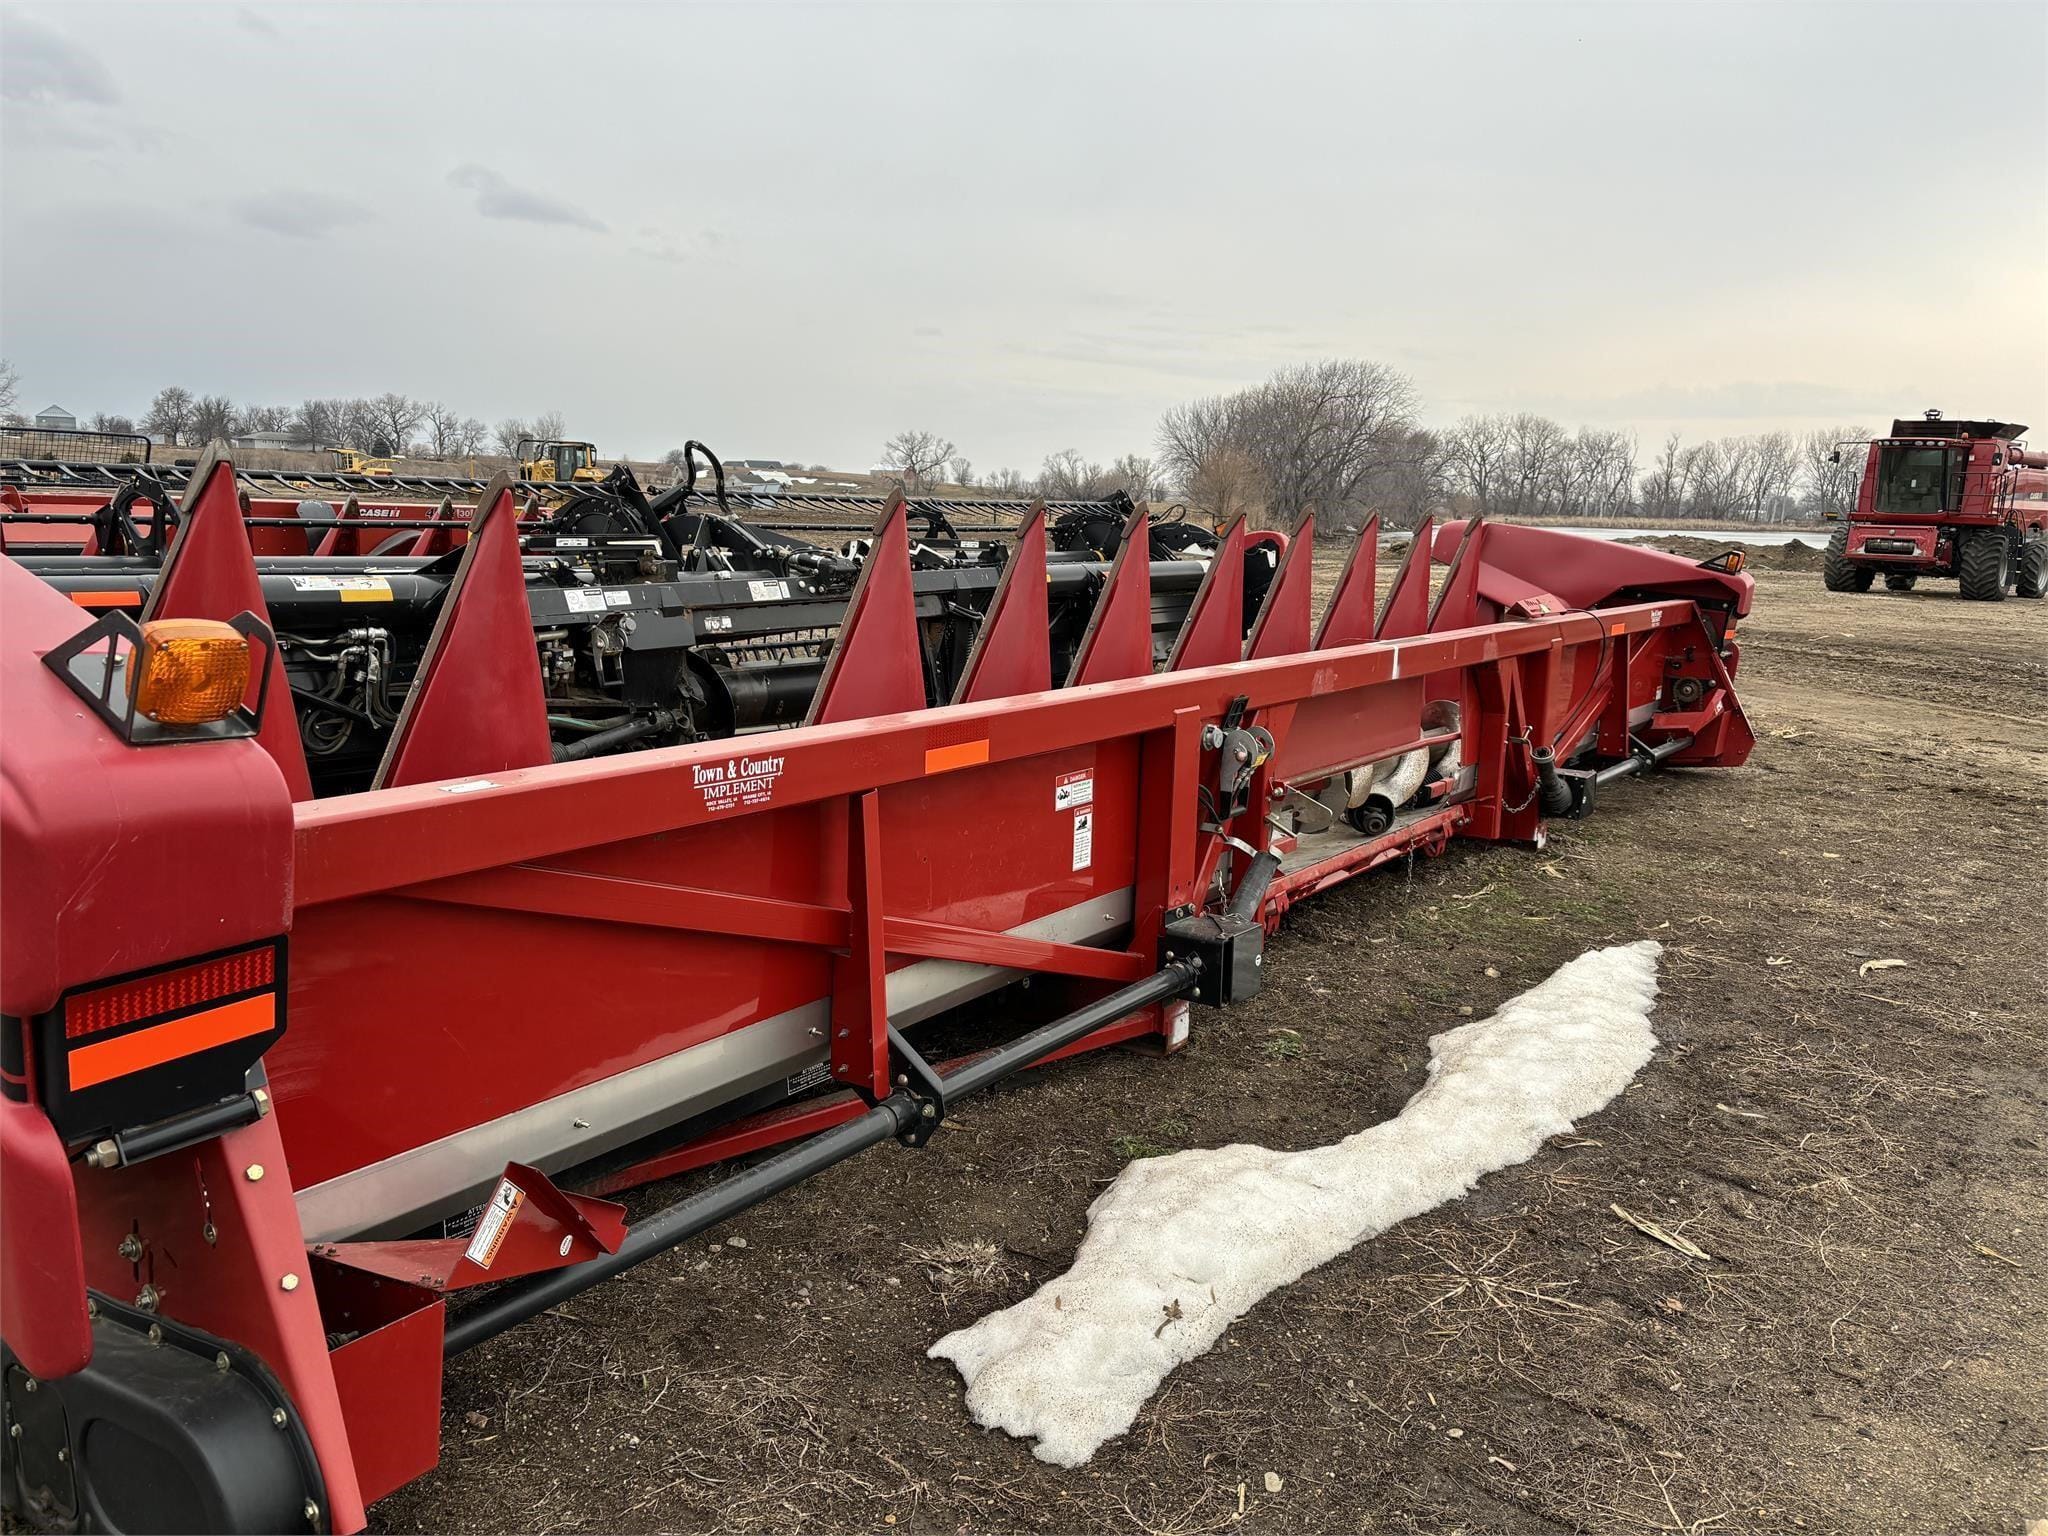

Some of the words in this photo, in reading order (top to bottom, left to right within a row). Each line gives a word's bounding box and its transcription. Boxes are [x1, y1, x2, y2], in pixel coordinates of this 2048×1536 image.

[359, 508, 389, 517] CASE
[692, 765, 723, 784] Town
[727, 759, 737, 779] &
[740, 756, 785, 777] Country
[703, 777, 775, 800] IMPLEMENT
[467, 1202, 489, 1215] ATTEN
[485, 1211, 514, 1260] WARNING
